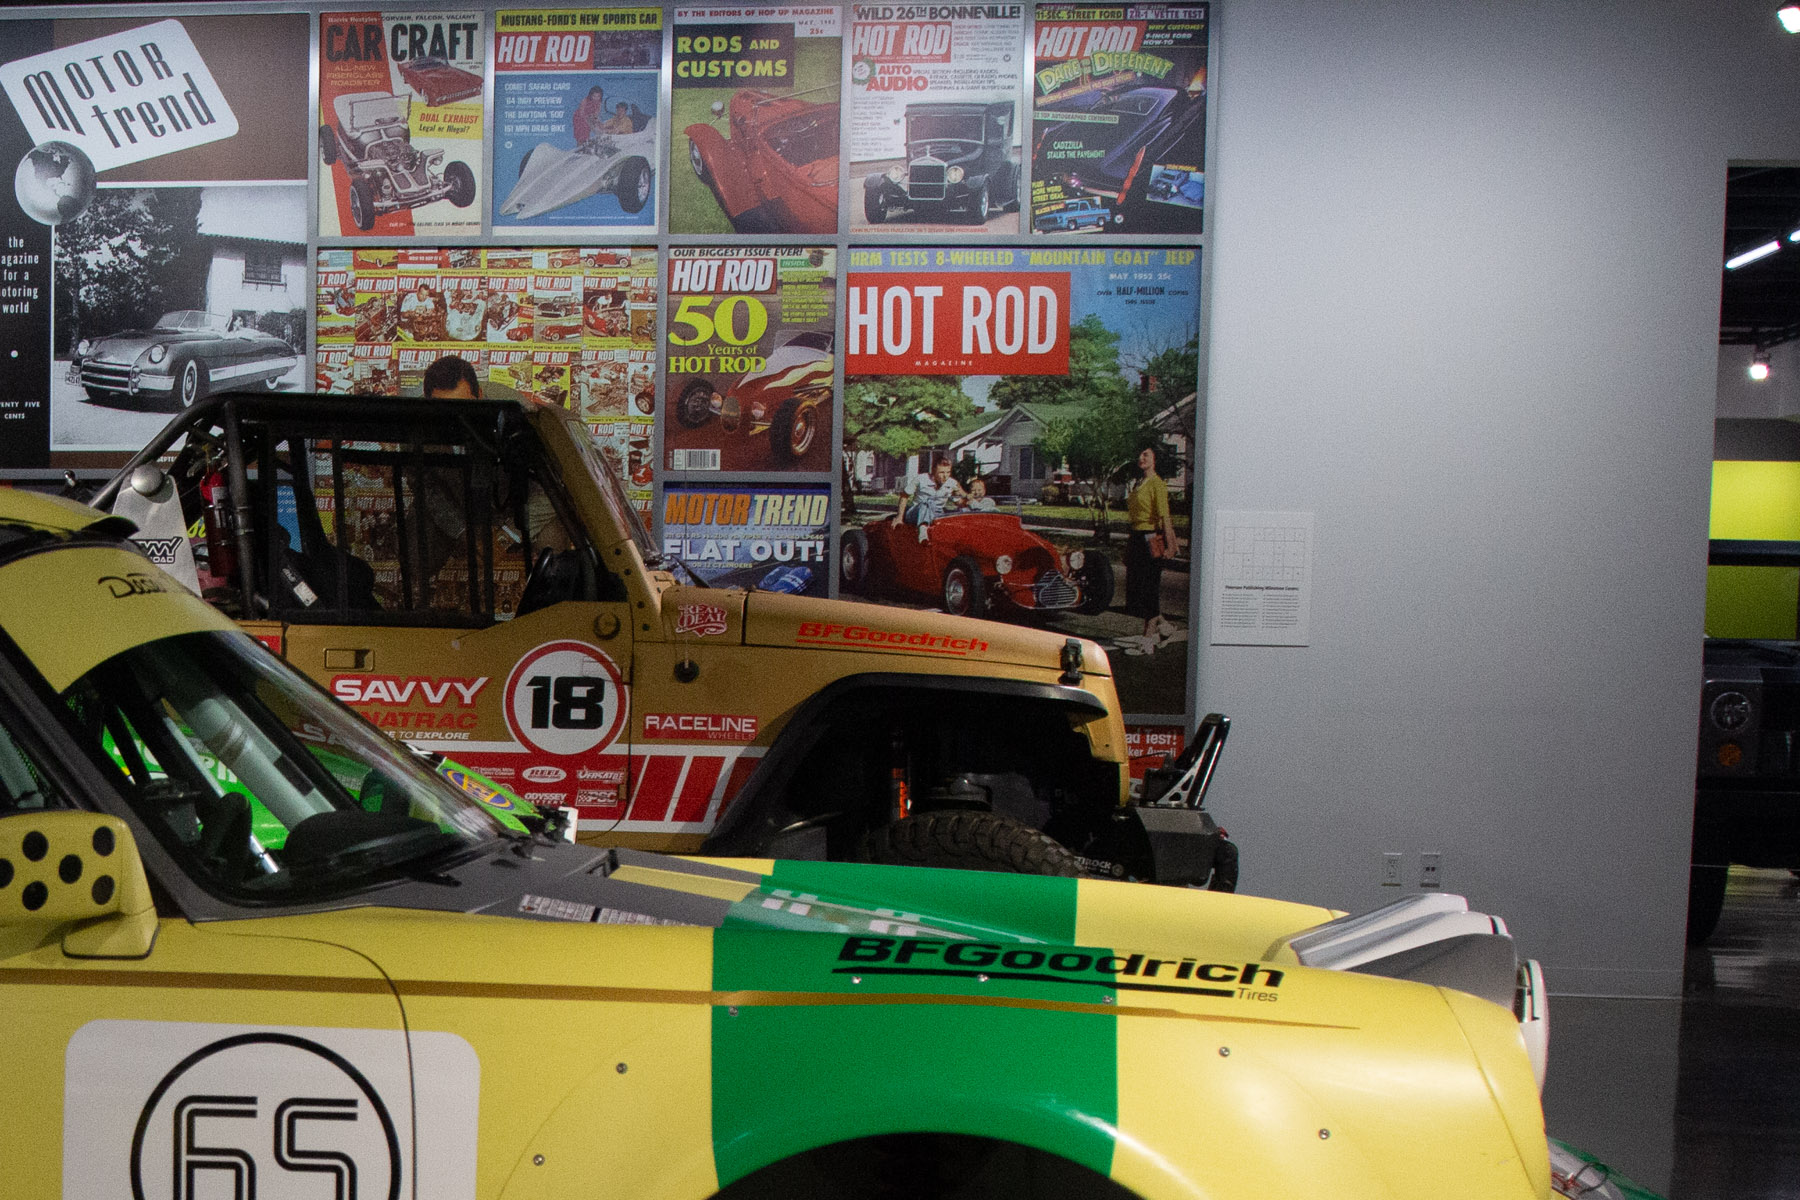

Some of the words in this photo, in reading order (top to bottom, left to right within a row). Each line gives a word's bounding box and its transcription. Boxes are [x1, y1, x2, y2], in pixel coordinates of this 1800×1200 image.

[579, 13, 600, 25] NEW
[603, 13, 637, 25] SPORTS
[639, 13, 657, 24] CAR
[856, 7, 894, 20] WILD
[896, 7, 927, 20] 26TH
[929, 6, 1021, 19] BONNEVILLE!
[1066, 11, 1096, 19] STREET
[1100, 10, 1123, 19] FORD
[1183, 10, 1203, 19] TEST
[326, 23, 383, 62] CAR
[391, 22, 479, 62] CRAFT
[677, 36, 742, 53] RODS
[749, 40, 780, 50] AND
[853, 25, 900, 56] HOT
[902, 24, 952, 56] ROD
[1036, 27, 1088, 58] HOT
[1084, 26, 1137, 55] ROD
[497, 35, 541, 63] HOT
[544, 35, 591, 63] ROD
[677, 60, 788, 78] CUSTOMS
[878, 65, 912, 76] AUTO
[23, 41, 174, 136] MOTOR
[552, 82, 570, 90] CARS
[866, 76, 928, 92] AUDIO
[92, 72, 216, 150] trend
[419, 113, 440, 123] DUAL
[442, 113, 479, 124] EXHAUST
[418, 123, 436, 133] Legal
[446, 125, 470, 134] Illegal?
[8, 236, 24, 248] the
[699, 249, 741, 257] BIGGEST
[774, 249, 804, 257] EVER!
[850, 252, 882, 266] HRM
[890, 252, 928, 266] TESTS
[935, 251, 1014, 265] 8-WHEELED
[1164, 250, 1195, 266] JEEP
[3, 269, 18, 281] for
[23, 271, 30, 281] a
[327, 273, 346, 284] ROD
[671, 260, 723, 292] HOT
[722, 259, 774, 292] ROD
[356, 279, 374, 291] HOT
[375, 279, 395, 291] ROD
[400, 277, 416, 289] HOT
[1116, 286, 1165, 297] HALF-MILLION
[2, 301, 30, 314] world
[668, 295, 768, 347] 50
[849, 286, 943, 356] HOT
[961, 285, 1058, 356] ROD
[707, 344, 743, 355] Years
[745, 344, 758, 355] of
[668, 356, 712, 373] HOT
[718, 356, 767, 373] ROD
[4, 412, 26, 420] CENTS
[664, 493, 751, 525] MOTOR
[753, 494, 829, 526] TREND
[663, 539, 741, 562] FLAT
[750, 539, 825, 562] OUT!
[681, 604, 720, 615] REAL
[683, 612, 727, 626] DEAL
[797, 621, 989, 652] BFGoodrich
[335, 677, 489, 704] SAVVY
[525, 675, 605, 730] 18
[645, 715, 756, 733] RACELINE
[400, 731, 414, 739] TO
[415, 731, 471, 740] EXPLORE
[708, 731, 756, 741] WHEELS
[1146, 734, 1177, 745] Test!
[524, 792, 568, 801] ODYSSEY
[836, 936, 1286, 988] BFGoodrich
[1237, 987, 1279, 1003] Tires
